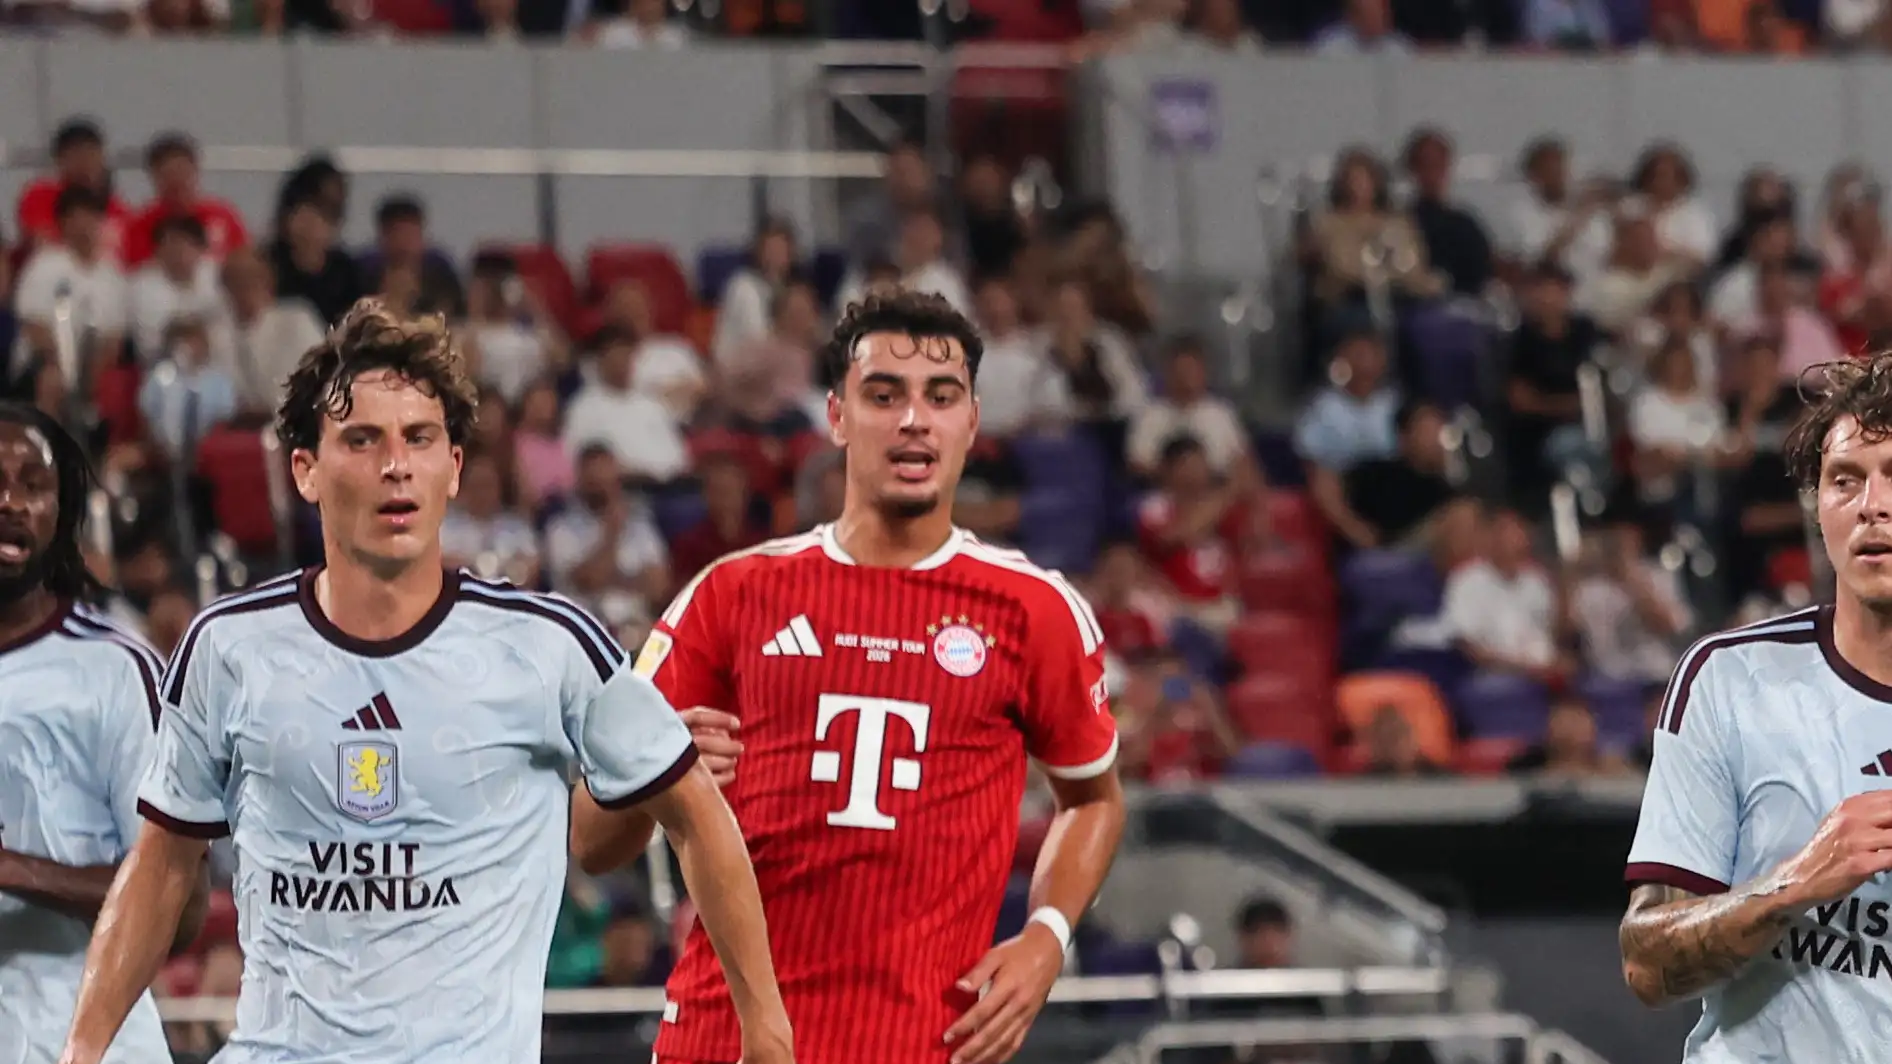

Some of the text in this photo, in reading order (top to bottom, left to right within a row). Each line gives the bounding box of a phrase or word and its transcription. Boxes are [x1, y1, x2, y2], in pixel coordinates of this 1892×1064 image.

[860, 635, 899, 651] SUMMER
[901, 640, 926, 655] TOUR
[309, 841, 420, 876] VISIT
[270, 870, 461, 913] RWANDA
